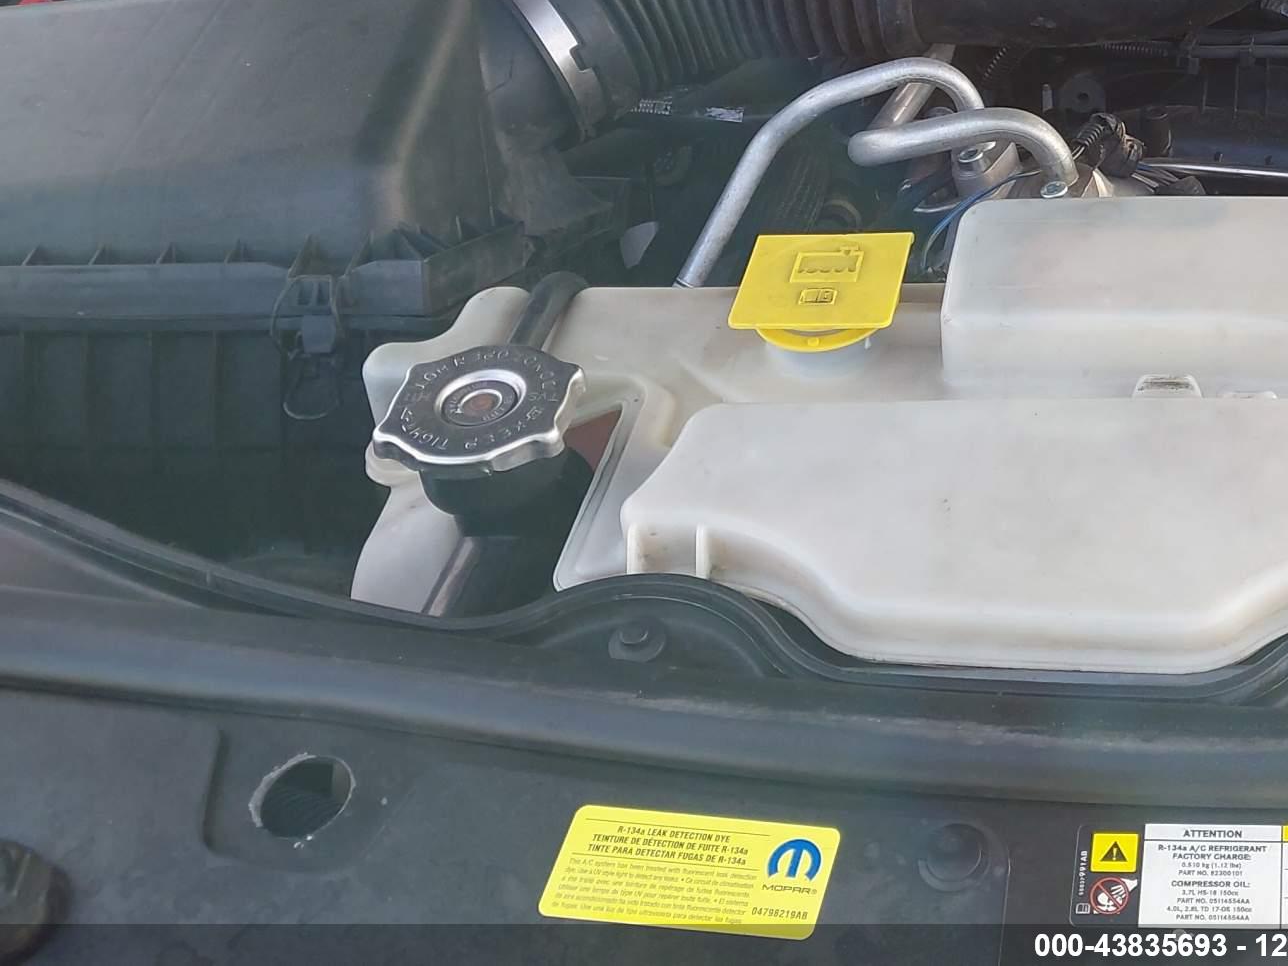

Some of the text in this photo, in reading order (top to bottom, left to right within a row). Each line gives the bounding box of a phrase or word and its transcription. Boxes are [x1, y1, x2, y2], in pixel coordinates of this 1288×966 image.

[617, 825, 731, 843] R-134a LEAK DETECTION DYE
[1183, 829, 1243, 838] ATTENTION
[592, 833, 629, 844] TEINTURE
[630, 837, 641, 846] DE
[686, 842, 696, 851] DE
[697, 843, 719, 853] FUITE
[721, 845, 748, 857] R-134a
[1189, 844, 1206, 853] A/C
[588, 843, 746, 866] TINTE PARA DETECTAR FUGAS DE R-134a
[1171, 880, 1231, 888] COMPRESSOR
